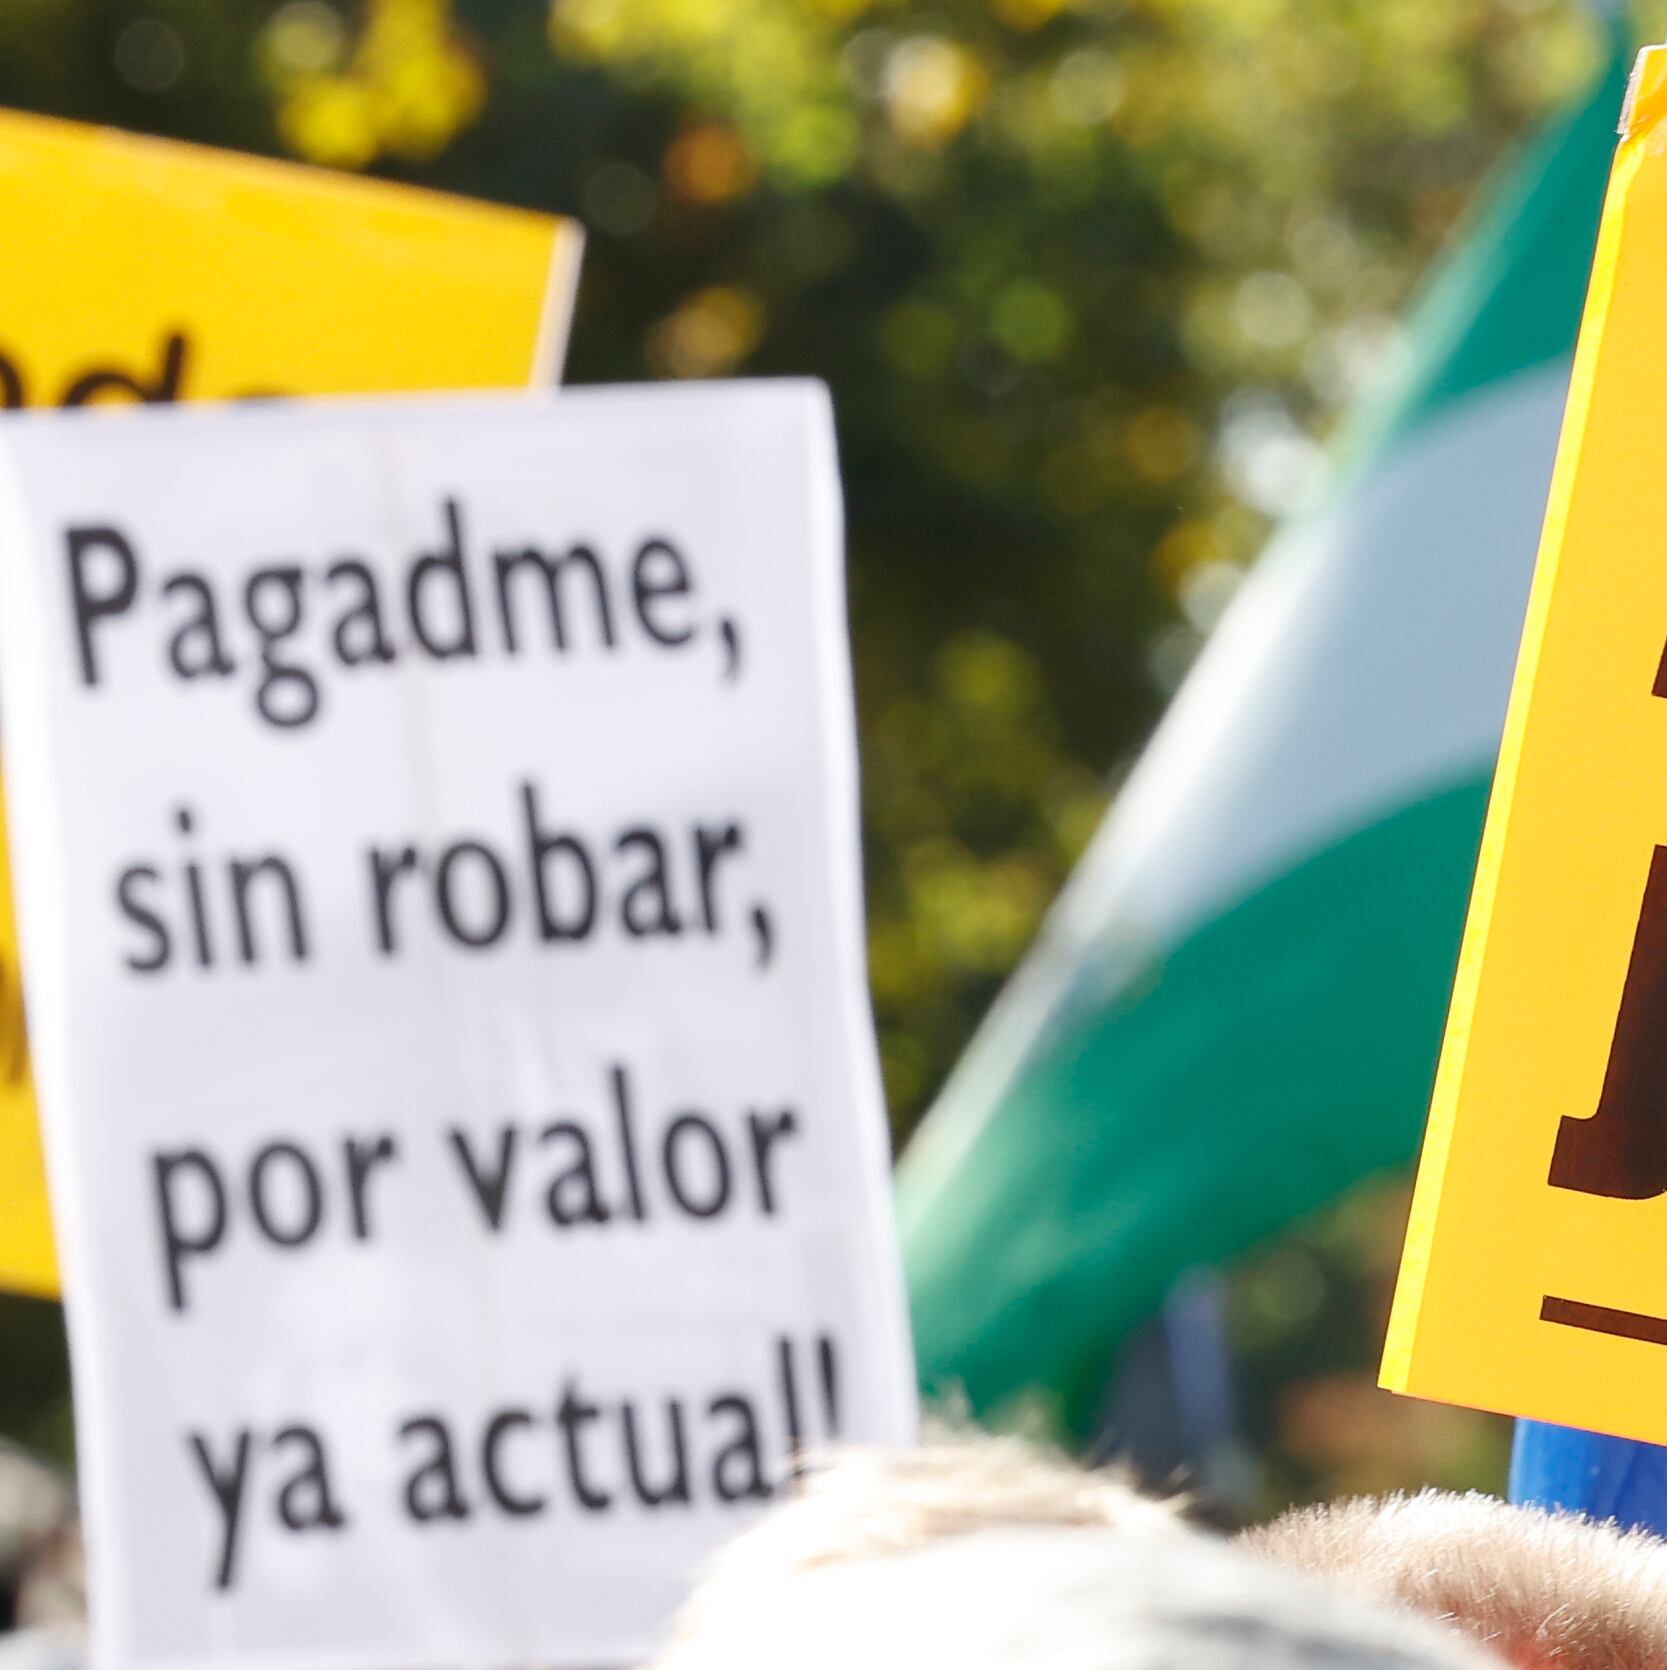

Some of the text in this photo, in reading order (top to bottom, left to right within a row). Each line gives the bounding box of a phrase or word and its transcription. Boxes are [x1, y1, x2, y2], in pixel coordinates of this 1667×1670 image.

[63, 497, 742, 732] Pagadme,
[115, 782, 775, 974] sin robar,
[151, 1064, 799, 1315] por valor
[187, 1424, 347, 1593] ya
